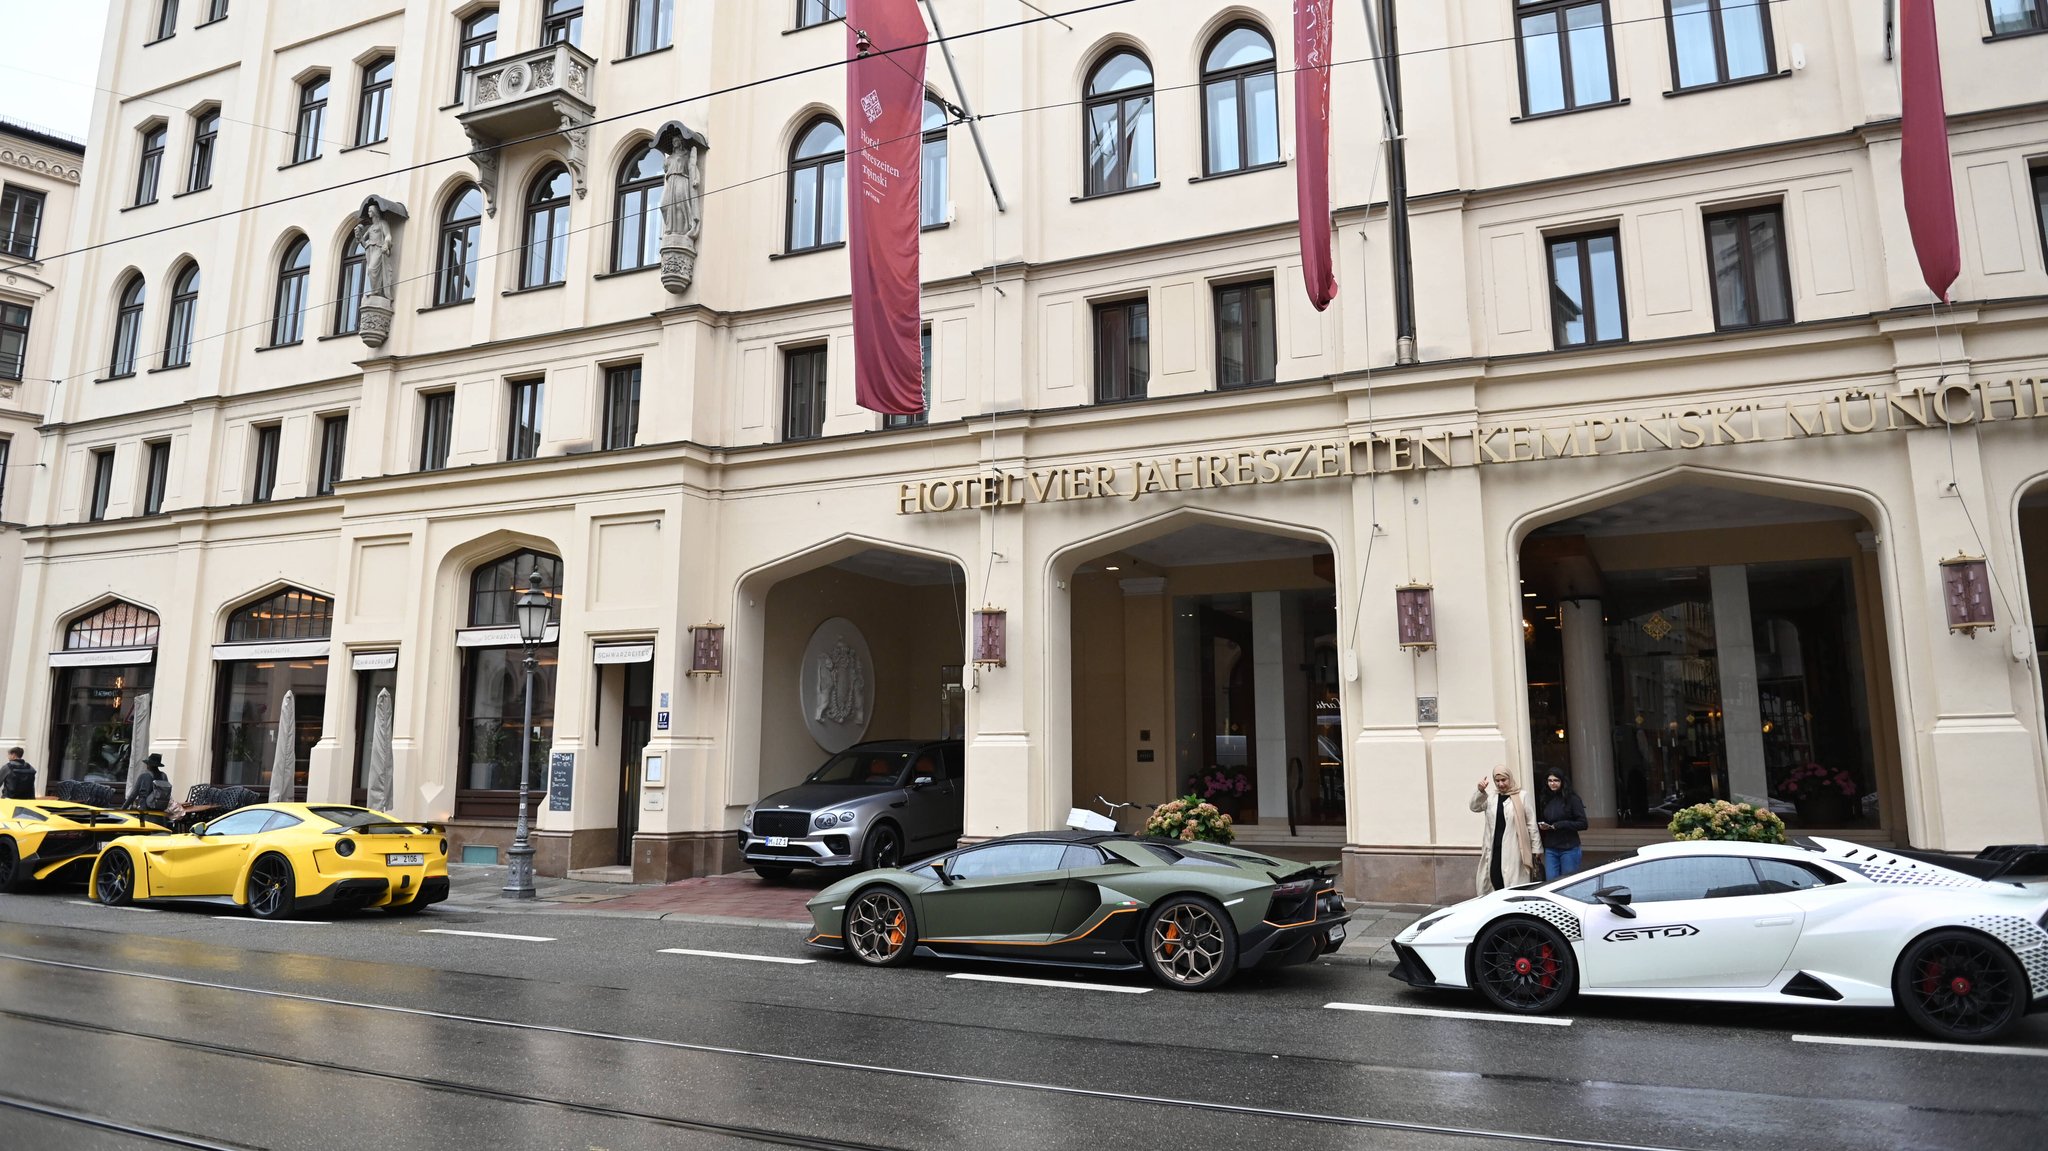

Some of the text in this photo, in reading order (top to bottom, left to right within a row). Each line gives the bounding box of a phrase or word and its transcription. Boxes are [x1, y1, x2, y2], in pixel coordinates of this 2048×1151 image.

[860, 128, 879, 151] Hotel
[896, 474, 1026, 516] HOTEL
[1027, 463, 1121, 503] VIER
[1129, 430, 1454, 502] JAHRESZEITEN
[1471, 403, 1764, 465] KEMPINSKI
[659, 712, 668, 722] 17
[1614, 927, 1687, 940] STO
